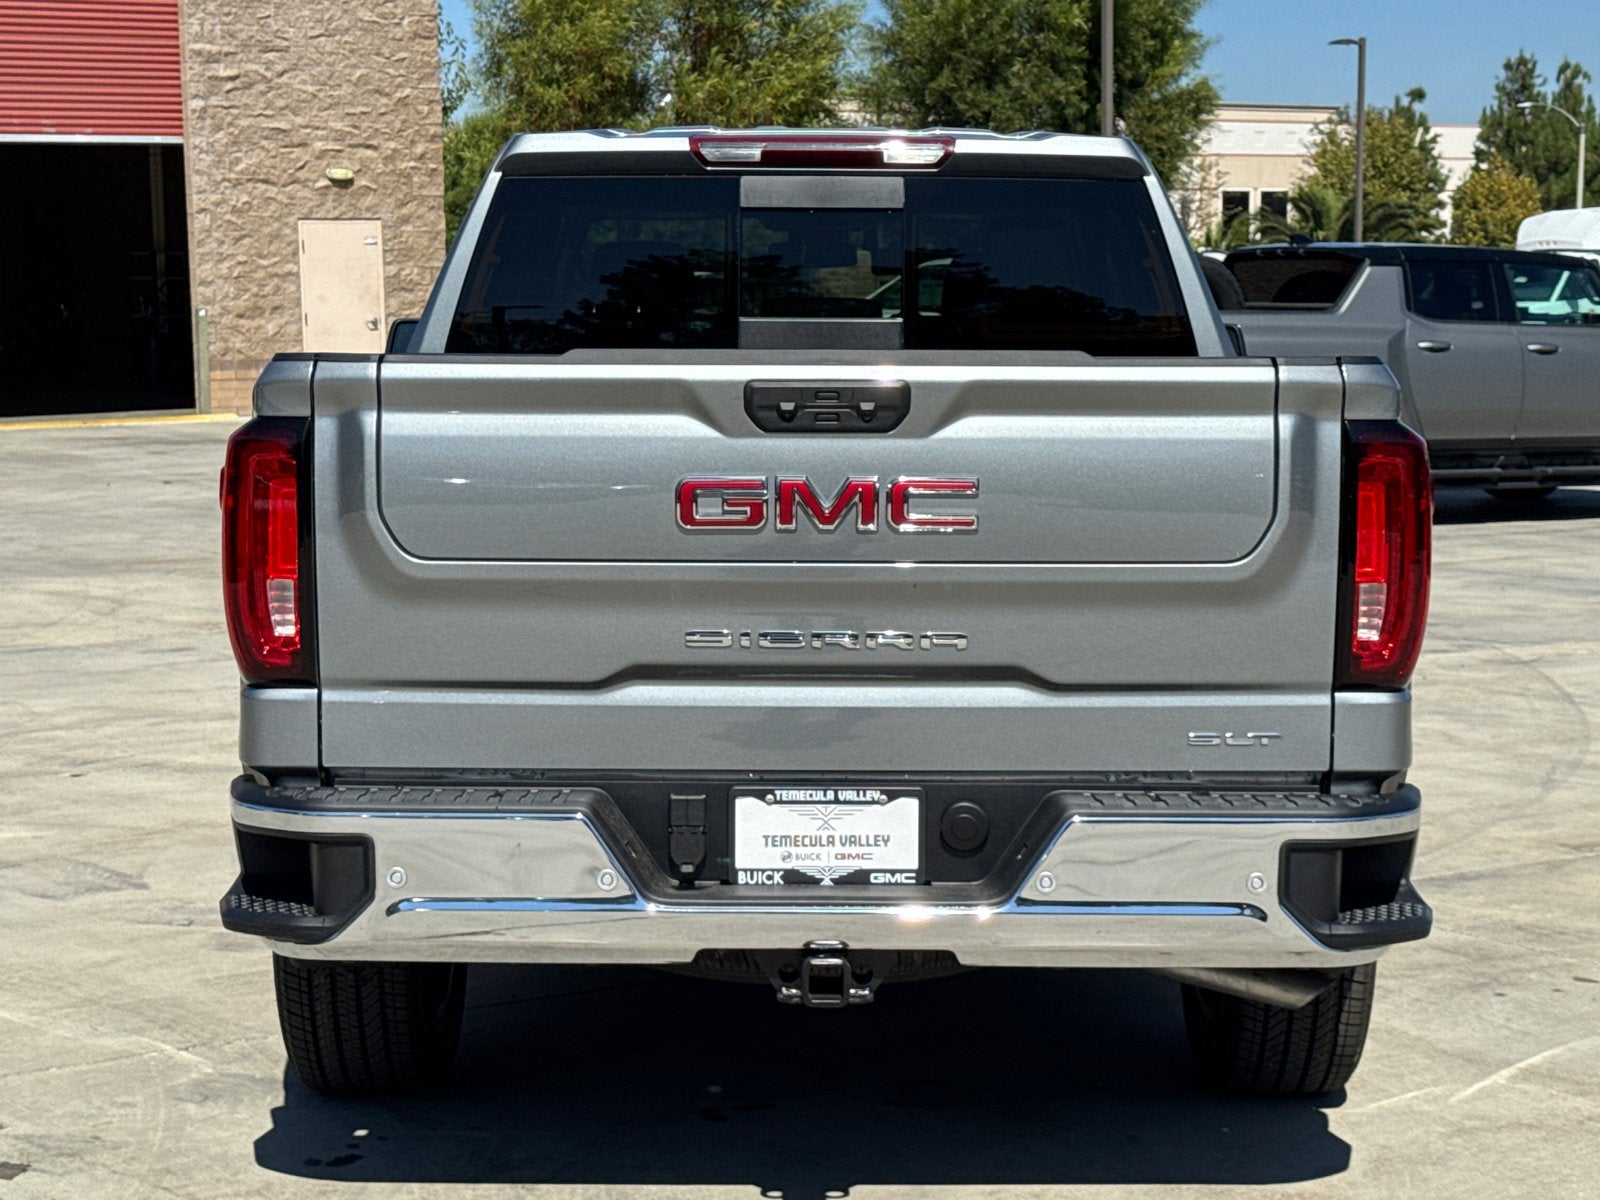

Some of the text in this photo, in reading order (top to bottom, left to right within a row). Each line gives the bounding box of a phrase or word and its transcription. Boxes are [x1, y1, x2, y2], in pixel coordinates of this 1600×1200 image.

[675, 475, 980, 532] GMC
[684, 629, 969, 650] SIERRA
[1187, 731, 1281, 747] SLT
[774, 790, 881, 802] TEMECULA VALLEY
[762, 834, 891, 848] TEMECULA VALLEY
[795, 852, 874, 861] BUICK GMC
[737, 870, 917, 885] BUICK GMC
